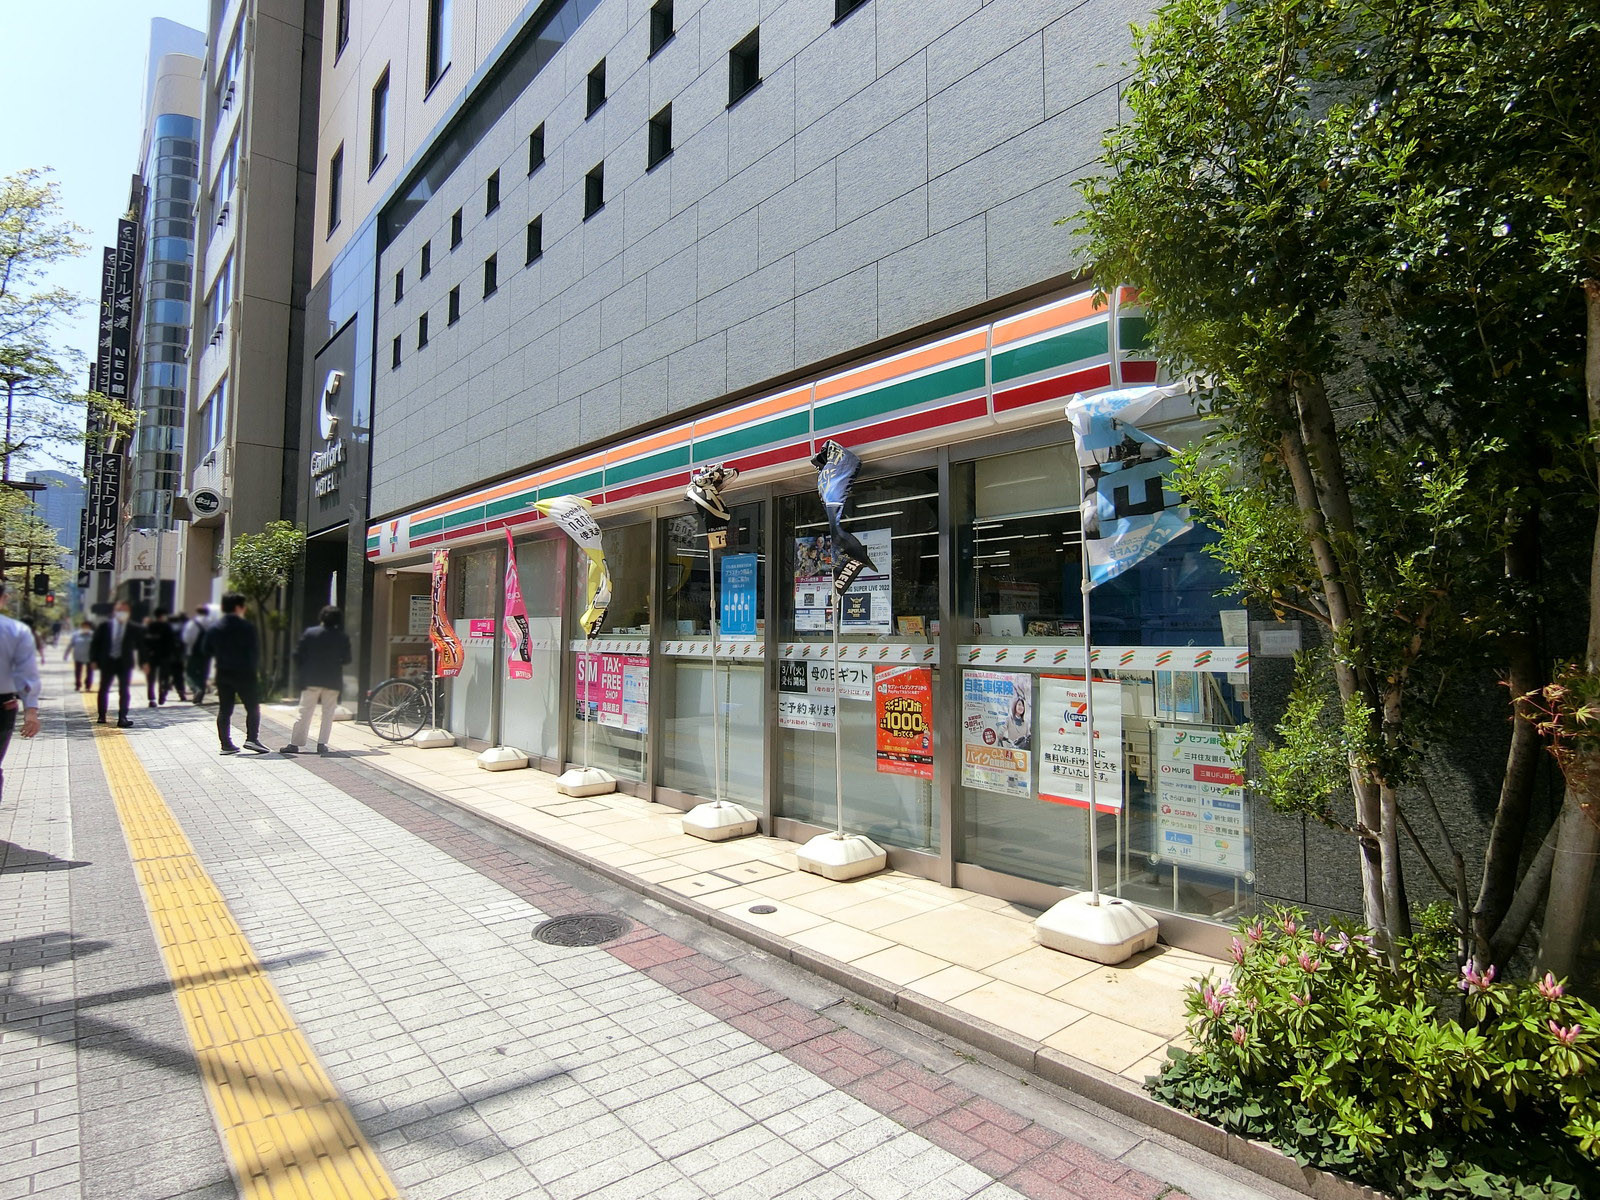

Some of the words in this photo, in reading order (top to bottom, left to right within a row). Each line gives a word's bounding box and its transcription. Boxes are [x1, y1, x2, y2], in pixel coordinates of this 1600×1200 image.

[115, 240, 134, 332] エトワール海渡
[311, 438, 342, 478] Comfort
[315, 472, 335, 498] HOTEL
[97, 473, 118, 567] エトワール海渡
[578, 660, 598, 682] SM
[781, 665, 805, 677] 3/1(火)
[811, 666, 868, 684] 母の日ギフト
[601, 673, 622, 690] FREE
[781, 676, 806, 687] 受付開始
[964, 678, 1014, 695] 自転車保険
[605, 689, 618, 699] SHOP
[779, 702, 836, 716] ご予約承ります
[895, 697, 922, 712] ジャンボ
[885, 712, 929, 731] 1000%
[1070, 714, 1087, 722] SPOT
[966, 751, 991, 764] バイク
[1044, 752, 1117, 771] 無料Wi-Fiサビスを
[1184, 752, 1226, 764] 三井住友銀行
[1053, 764, 1109, 782] 終了いたしす。
[1172, 767, 1191, 775] MUFG
[1200, 770, 1236, 780] 三菱UFJ銀行
[1174, 809, 1198, 818] ちばぎん
[1215, 826, 1240, 835] 信用金庫
